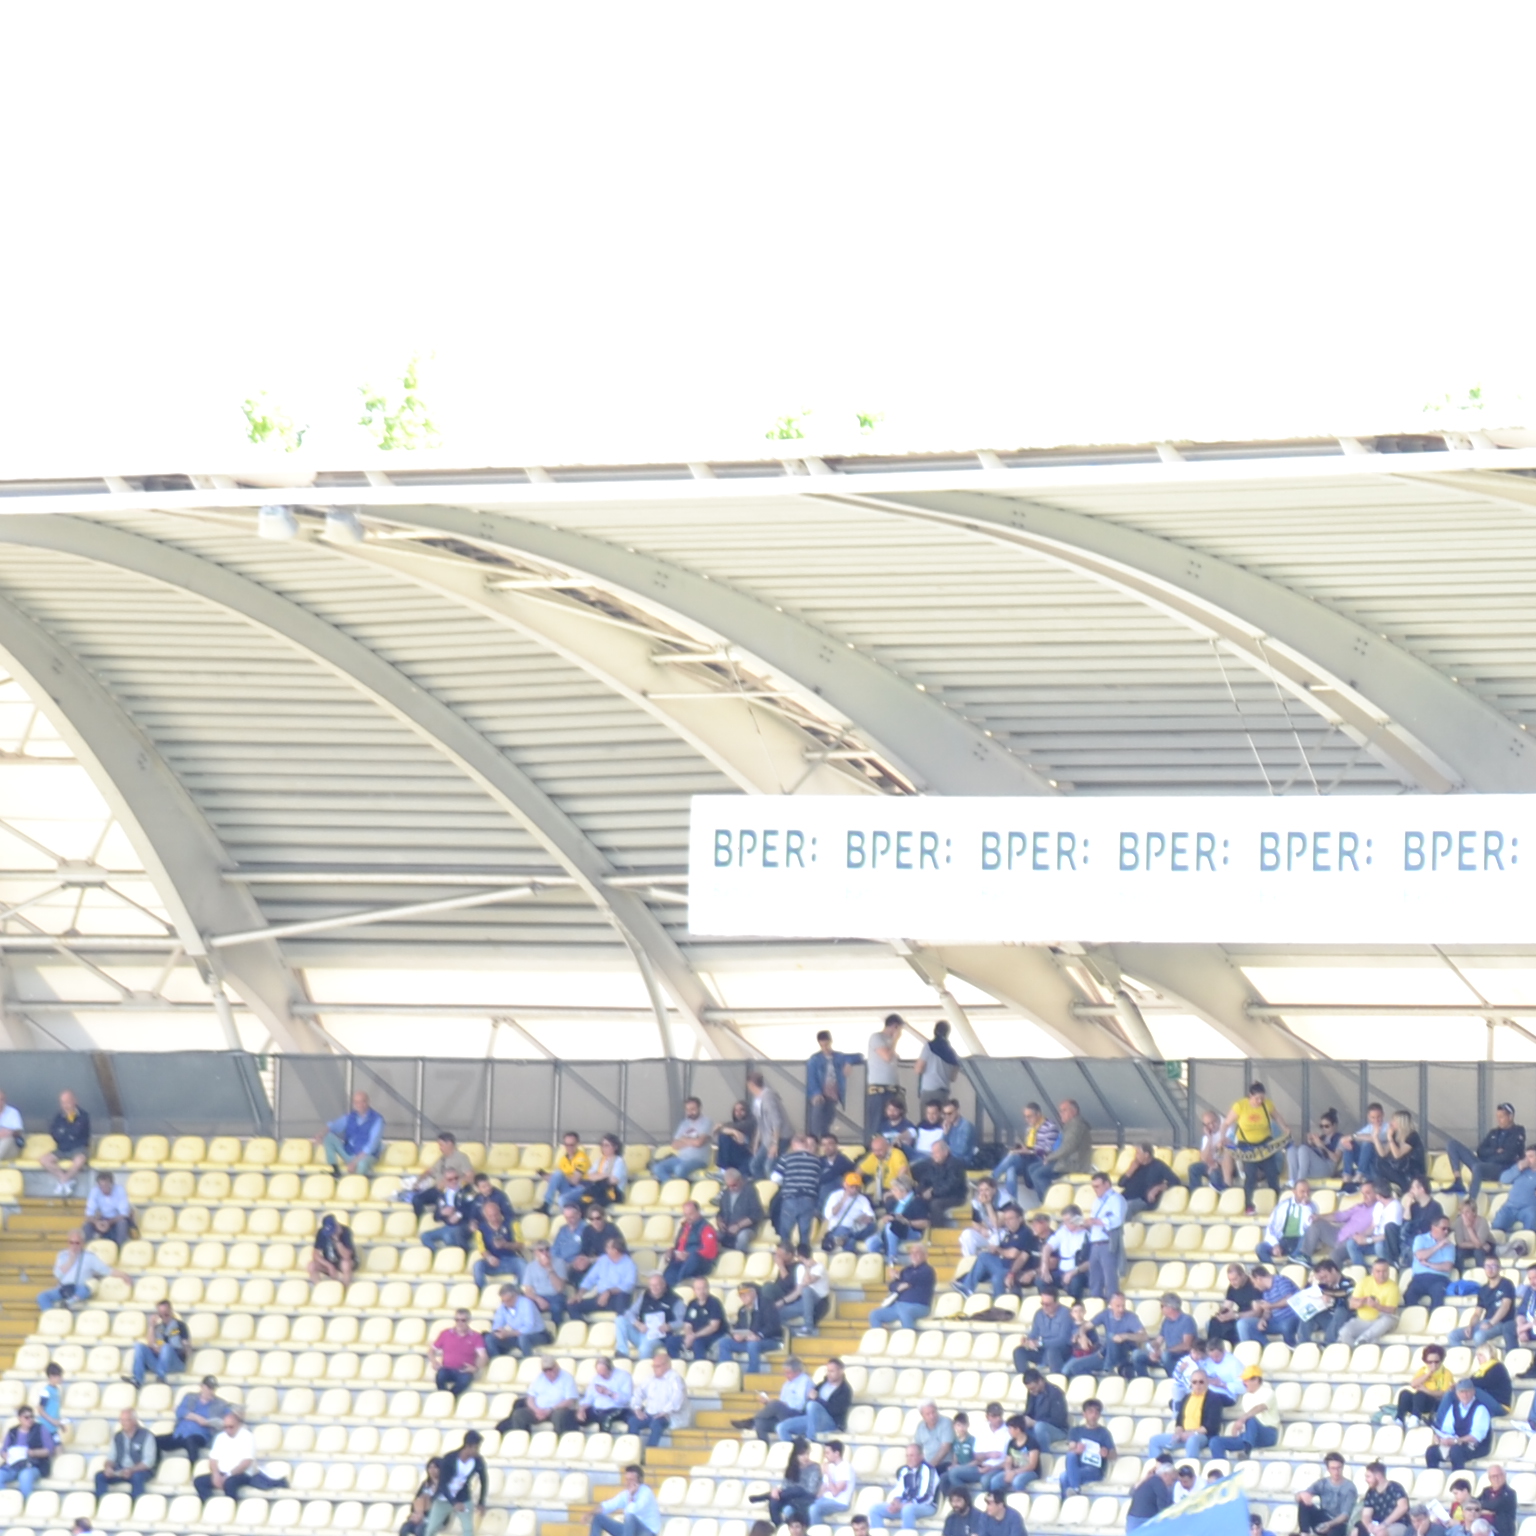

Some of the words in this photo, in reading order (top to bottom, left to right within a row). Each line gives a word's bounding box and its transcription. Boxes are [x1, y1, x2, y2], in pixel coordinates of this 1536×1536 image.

[714, 829, 816, 868] BPER:
[847, 830, 951, 869] BPER:
[982, 832, 1089, 871] BPER:
[1120, 832, 1229, 871] BPER:
[1260, 832, 1372, 871] BPER:
[1404, 831, 1518, 871] BPER:
